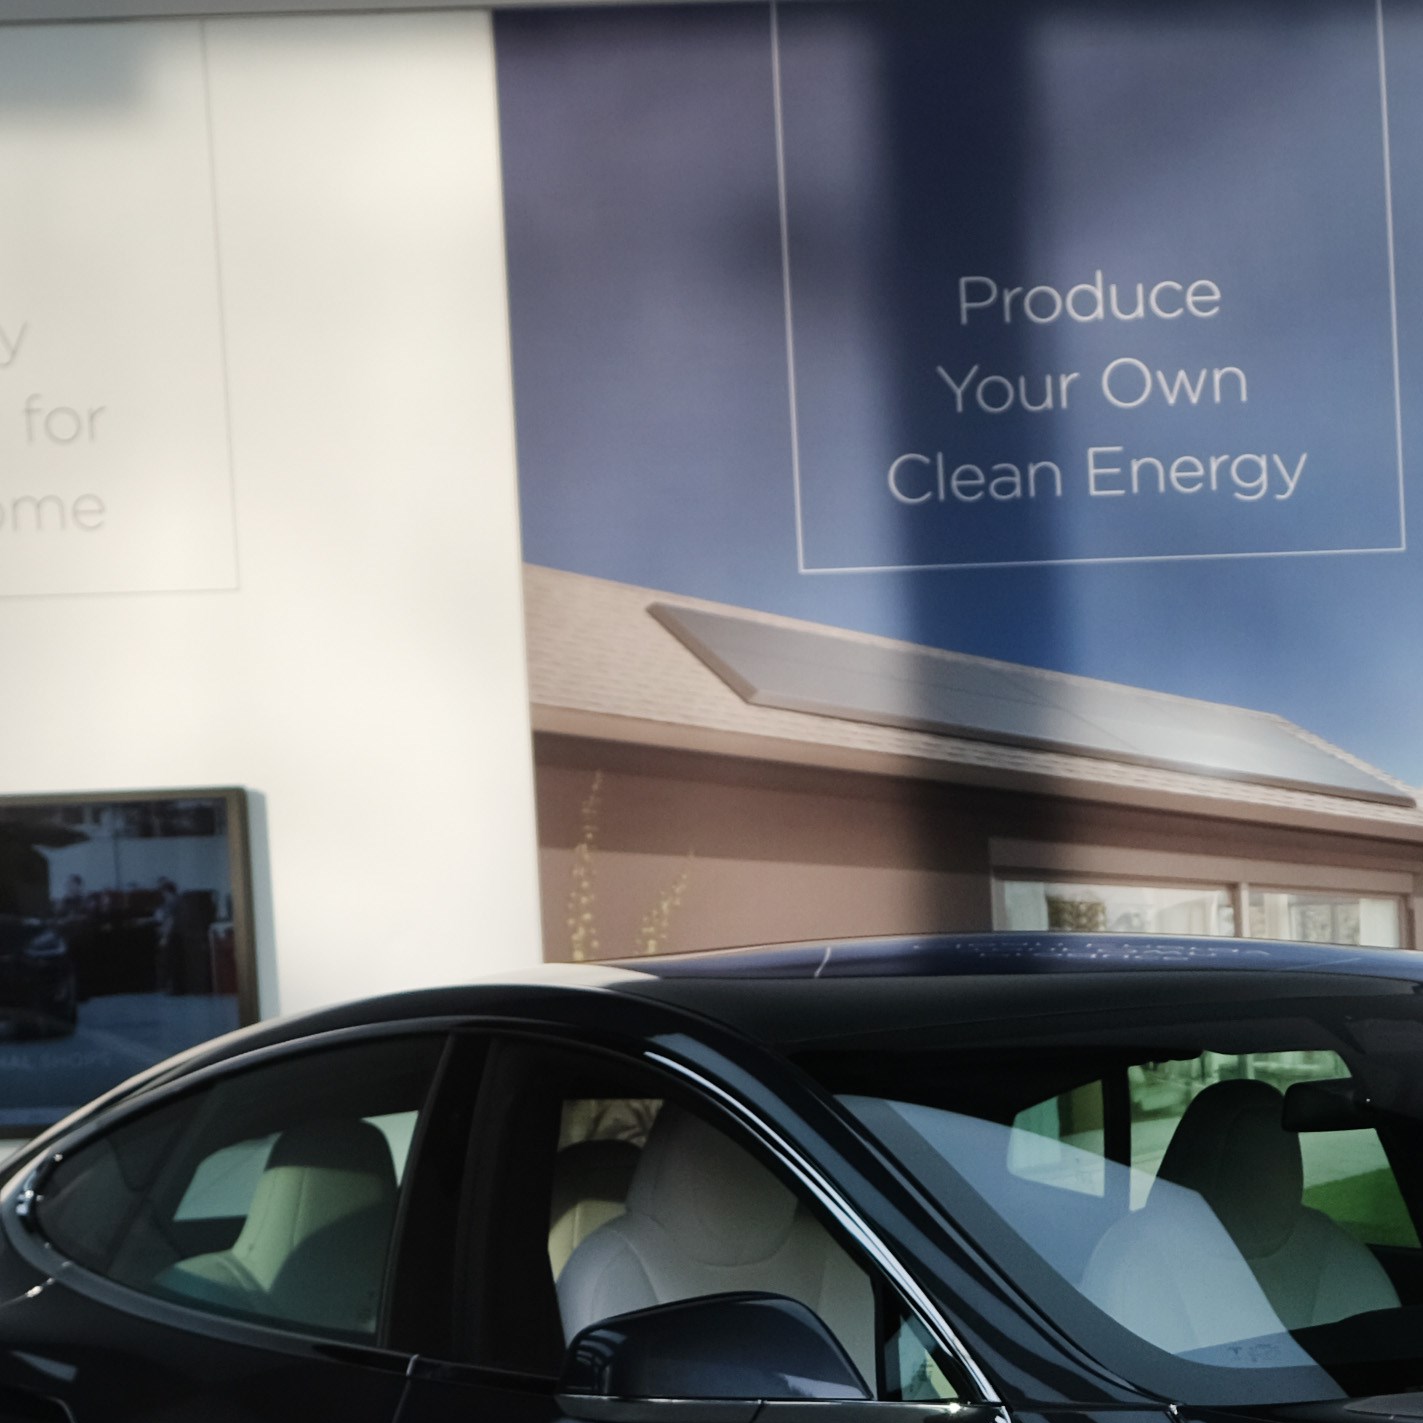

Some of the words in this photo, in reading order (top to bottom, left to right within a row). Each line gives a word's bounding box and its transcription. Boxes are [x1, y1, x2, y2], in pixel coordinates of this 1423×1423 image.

[959, 269, 1221, 324] Produce
[936, 364, 1080, 413] Your
[1102, 358, 1248, 408] Own
[22, 392, 107, 446] for
[887, 452, 1062, 504] Clean
[1087, 446, 1308, 501] Energy
[0, 493, 107, 533] me
